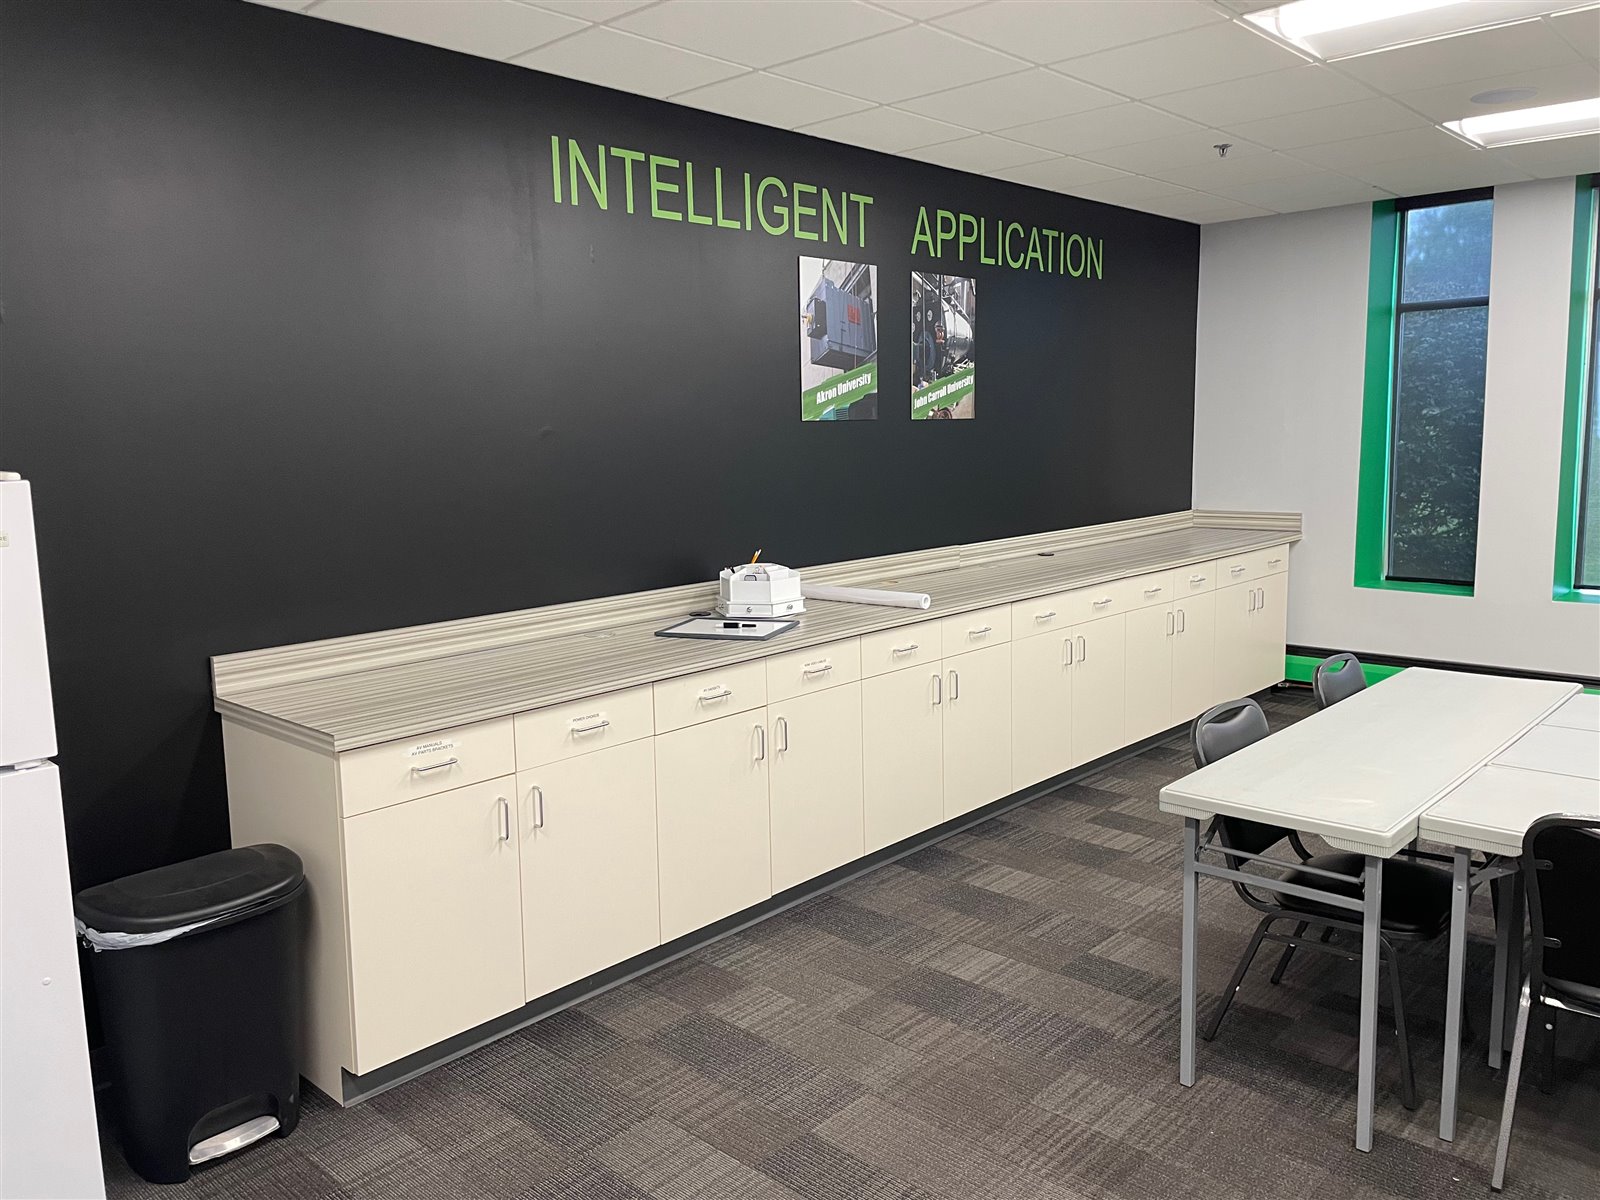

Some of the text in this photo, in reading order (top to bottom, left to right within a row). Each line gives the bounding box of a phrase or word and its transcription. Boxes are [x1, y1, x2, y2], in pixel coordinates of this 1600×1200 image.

[551, 135, 1104, 280] INTELLIGENT APPLICATION
[816, 373, 872, 405] Akron University
[914, 375, 974, 410] John Carroll University
[423, 741, 442, 749] MANUALS
[432, 744, 454, 752] BRACKETS
